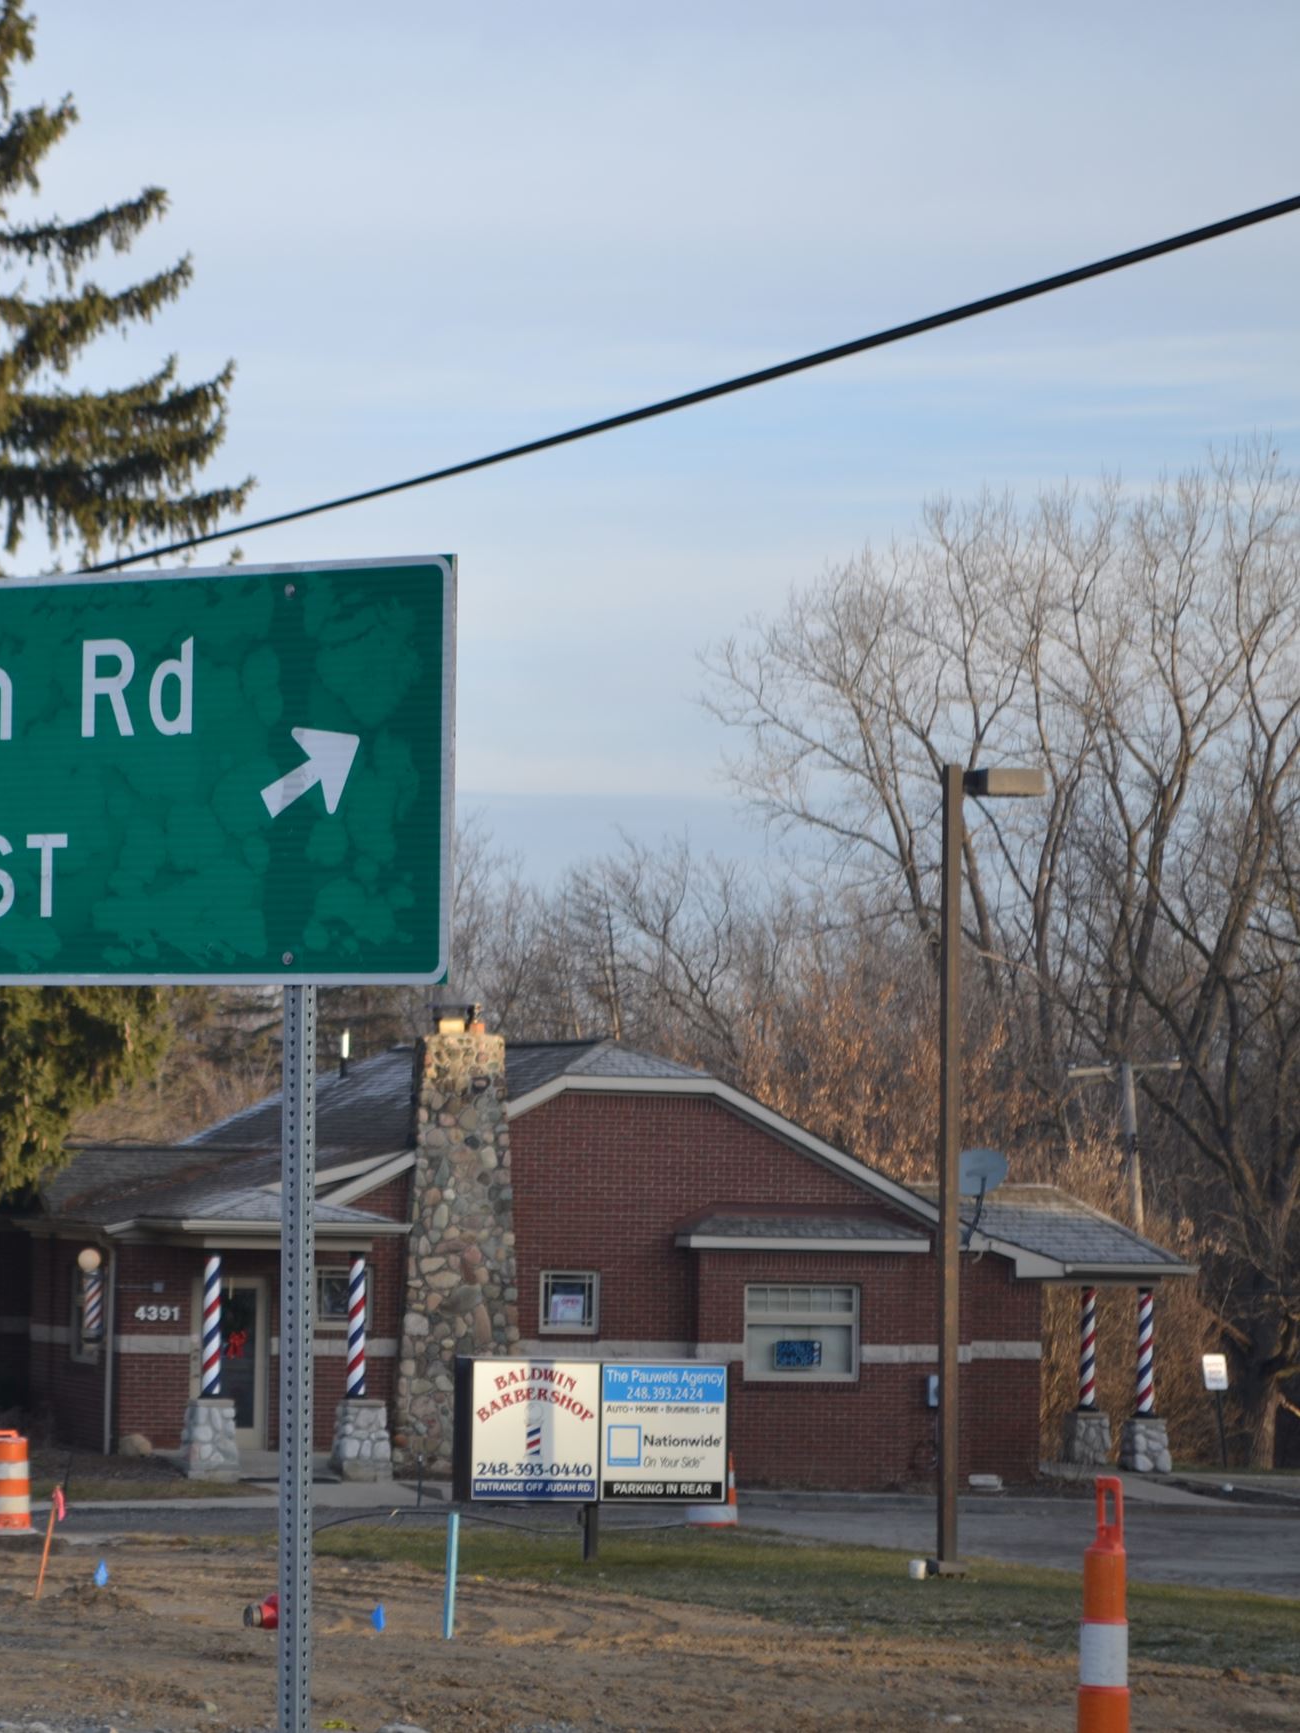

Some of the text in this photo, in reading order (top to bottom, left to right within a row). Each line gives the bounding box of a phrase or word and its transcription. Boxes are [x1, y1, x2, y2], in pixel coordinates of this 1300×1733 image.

[80, 635, 195, 738] Rd
[134, 1305, 180, 1321] 4391
[493, 1367, 577, 1392] BALDWIN
[606, 1369, 725, 1387] The Pauwels Agency
[626, 1386, 704, 1400] 248.393.2424
[476, 1387, 594, 1423] BARBERSHOP
[477, 1462, 592, 1477] 248-393-0440
[643, 1456, 657, 1468] On
[659, 1456, 679, 1468] Your
[475, 1482, 524, 1492] ENTRANCE
[525, 1482, 544, 1493] OFF
[545, 1483, 576, 1493] JUDAH
[613, 1482, 712, 1494] PARKING IN REAR
